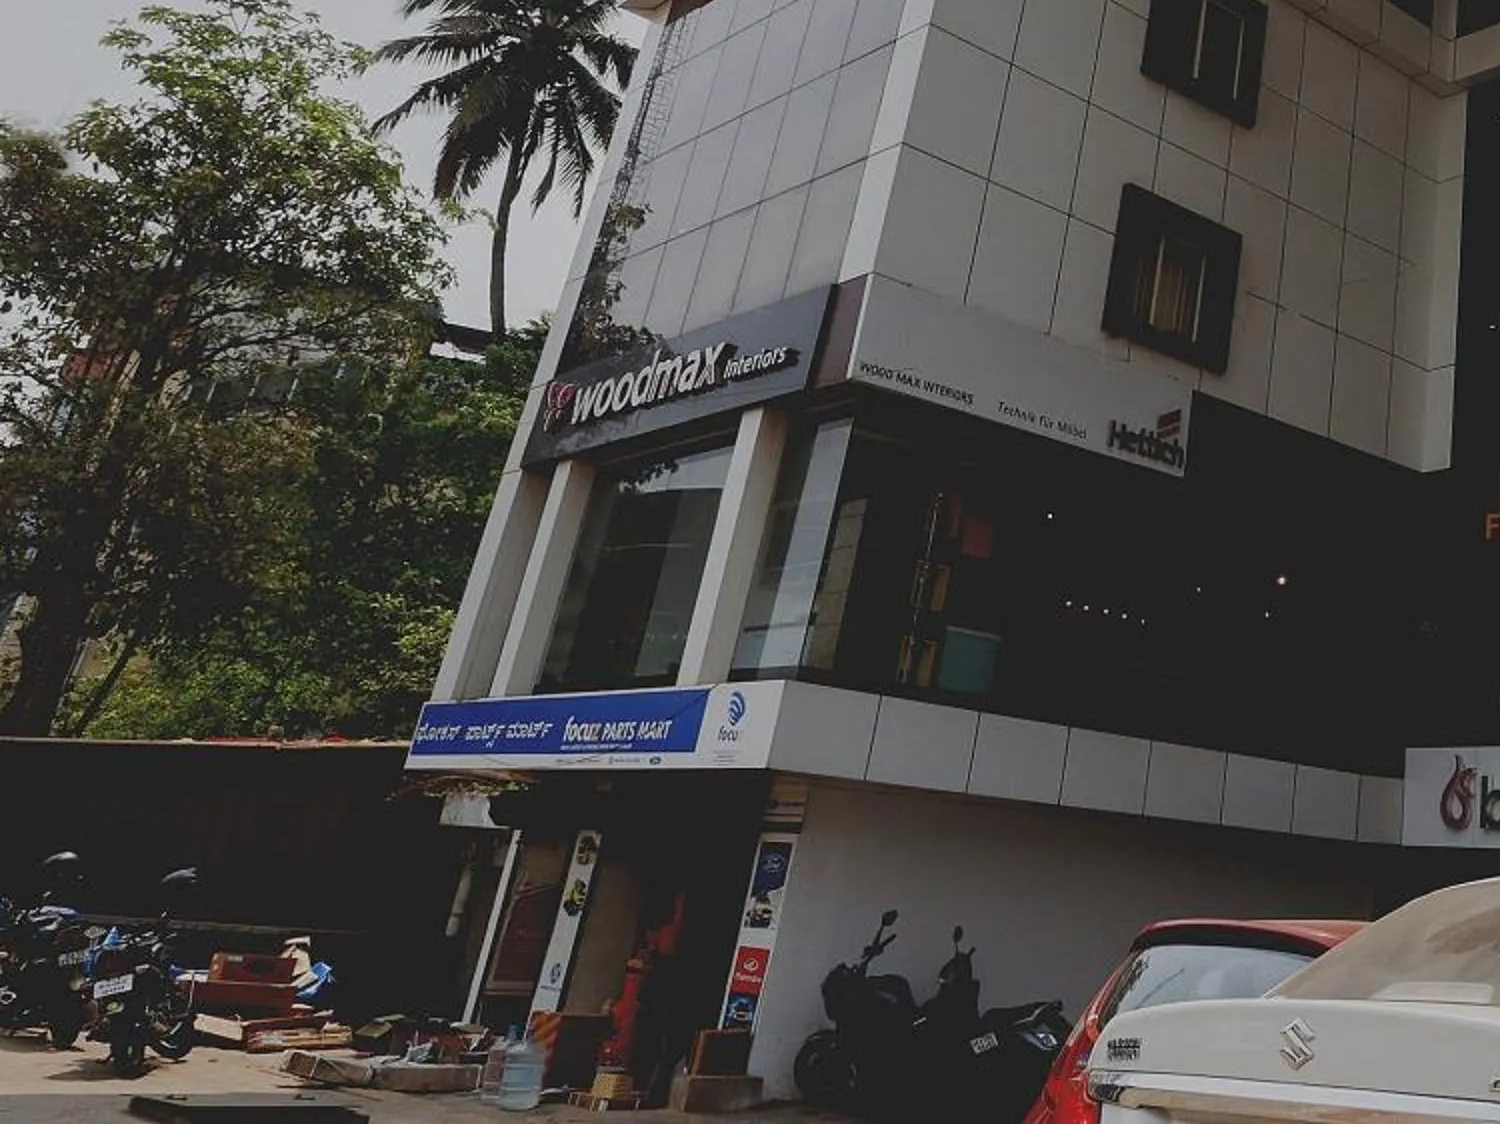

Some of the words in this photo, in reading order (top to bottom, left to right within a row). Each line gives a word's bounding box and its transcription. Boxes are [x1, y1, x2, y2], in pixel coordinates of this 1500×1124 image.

[571, 340, 735, 426] woodmax
[859, 360, 894, 380] WOOD
[895, 372, 921, 390] MAX
[922, 379, 975, 406] INTERIORS
[1106, 420, 1185, 469] Hettich
